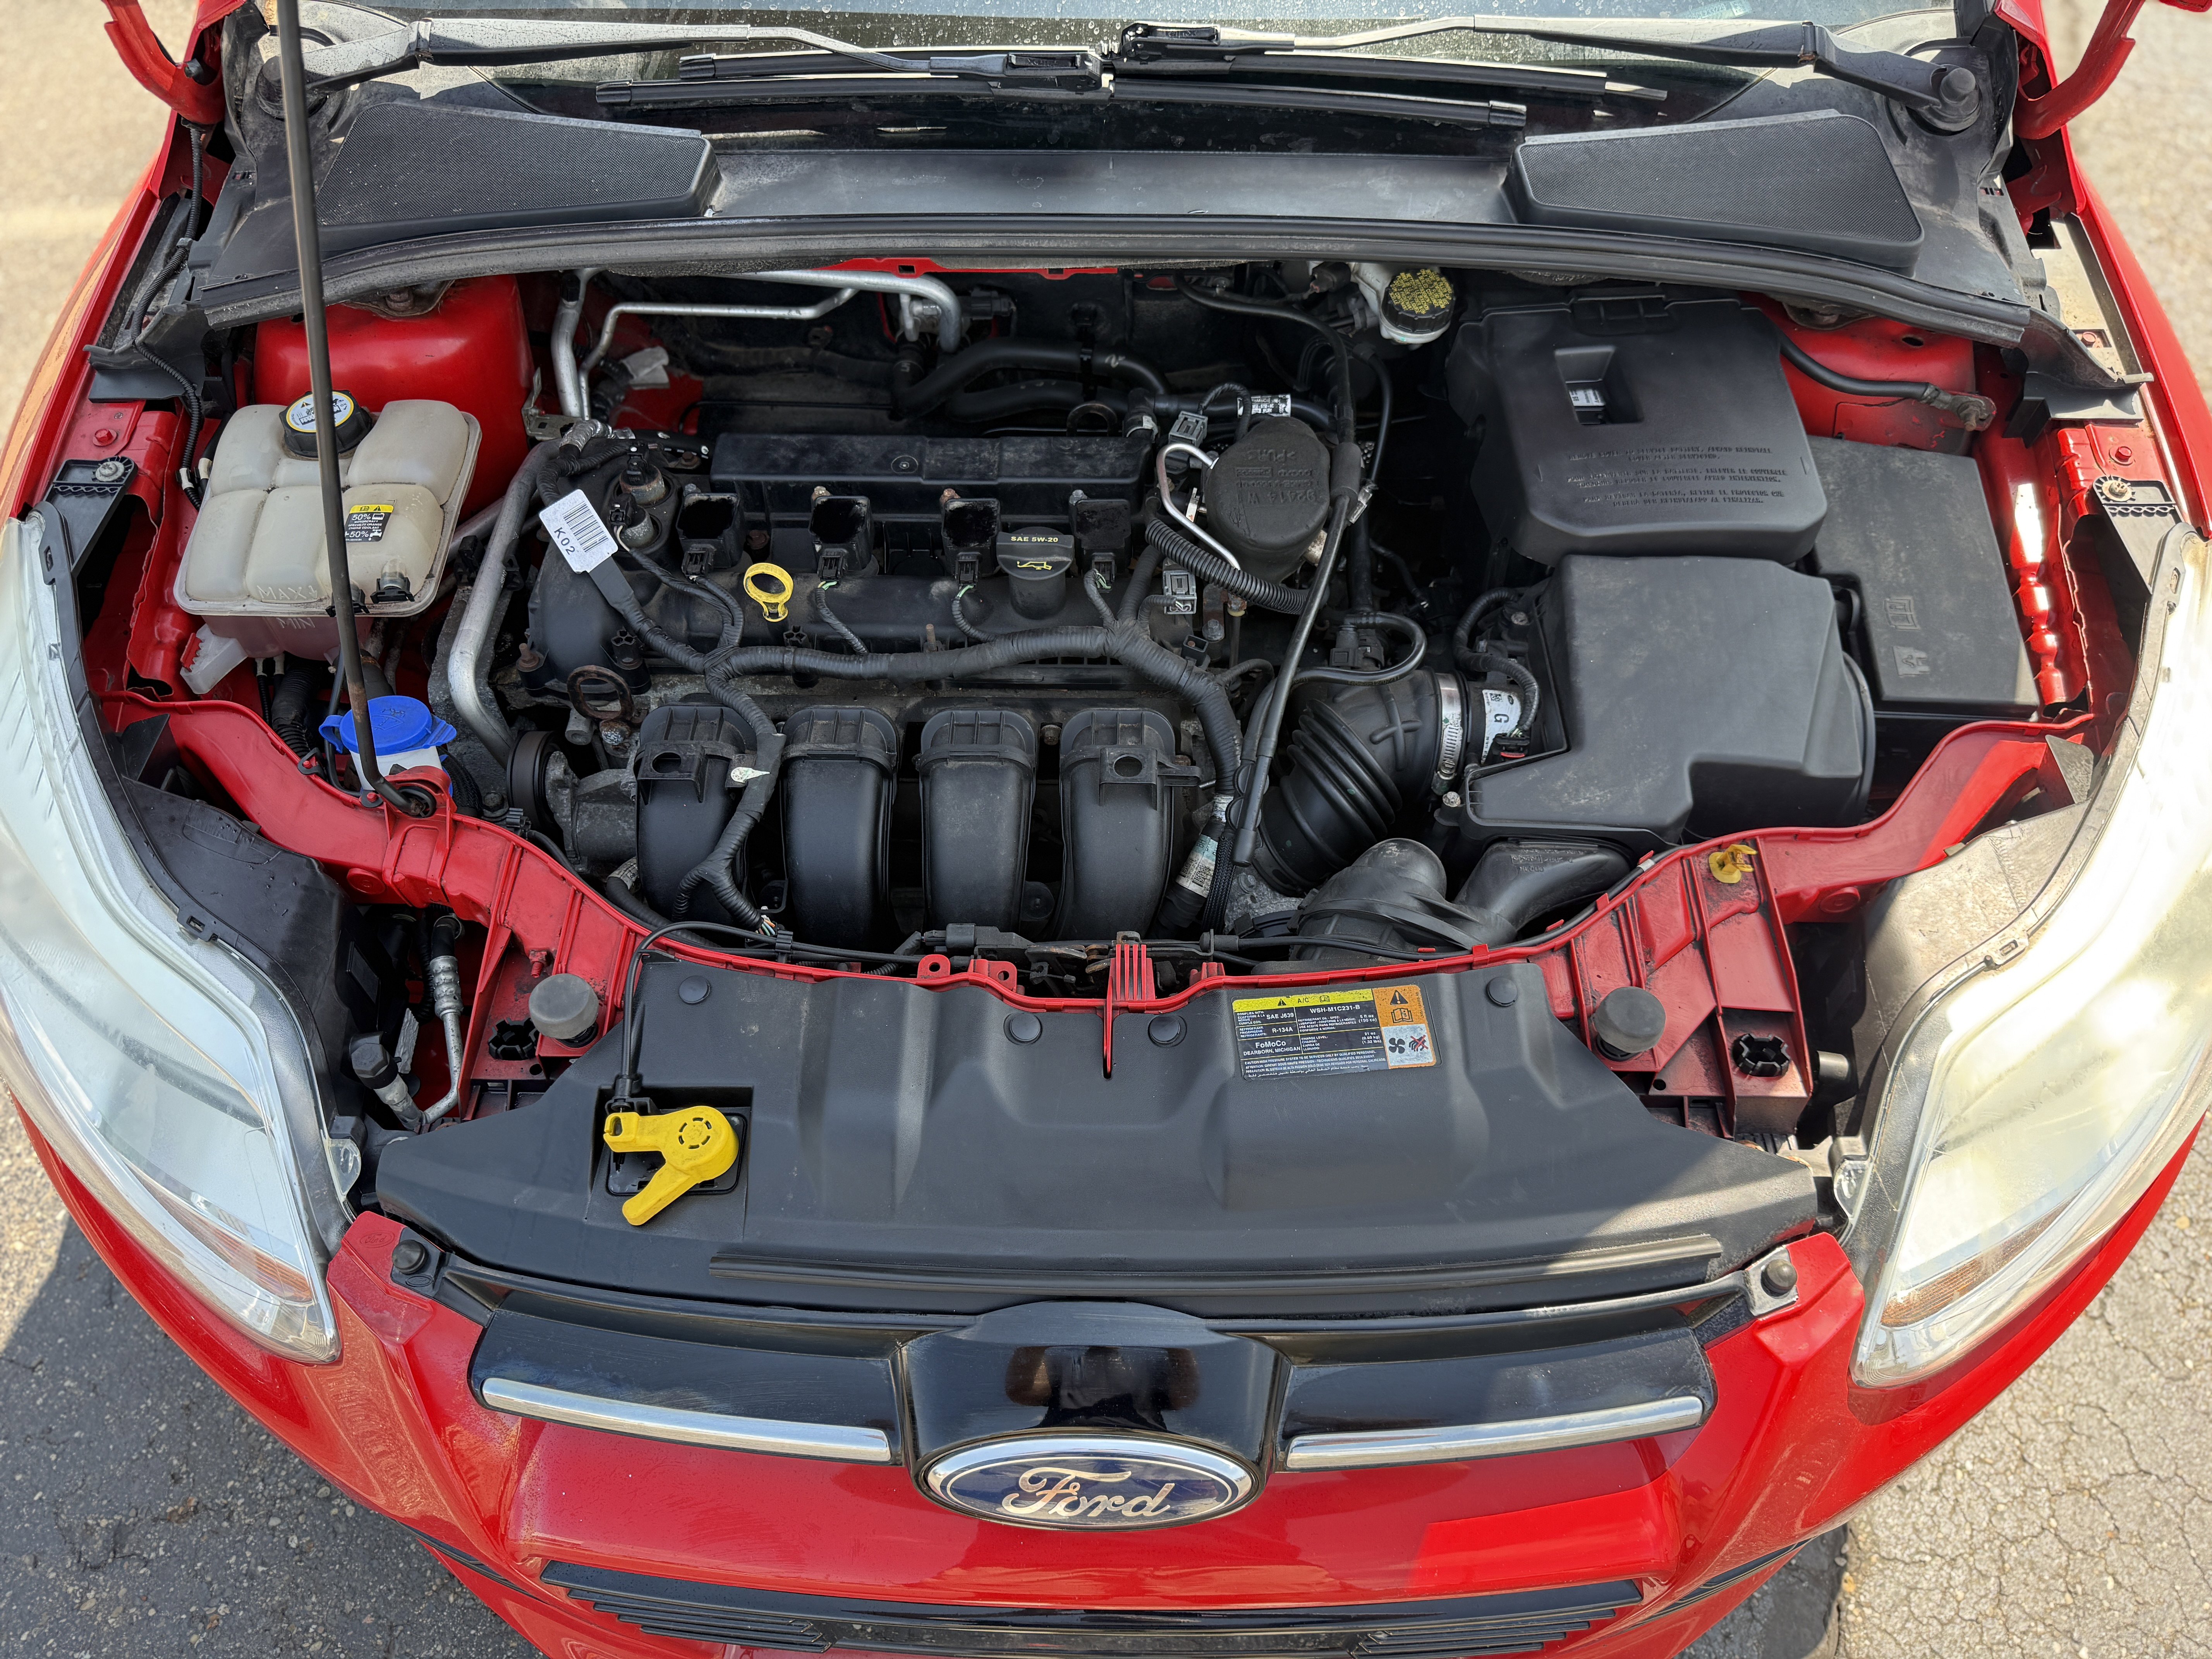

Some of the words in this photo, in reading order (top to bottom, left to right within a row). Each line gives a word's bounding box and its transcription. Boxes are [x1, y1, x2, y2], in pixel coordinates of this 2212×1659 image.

[554, 527, 575, 555] K02
[257, 585, 307, 600] MAX
[276, 617, 315, 629] MIN
[1494, 714, 1509, 723] G
[1197, 839, 1206, 848] BH
[1309, 1005, 1361, 1014] WSH-M1C231-B
[1255, 1039, 1286, 1049] FoMoCo
[365, 1234, 387, 1243] Ford
[1001, 1466, 1175, 1518] Ford
